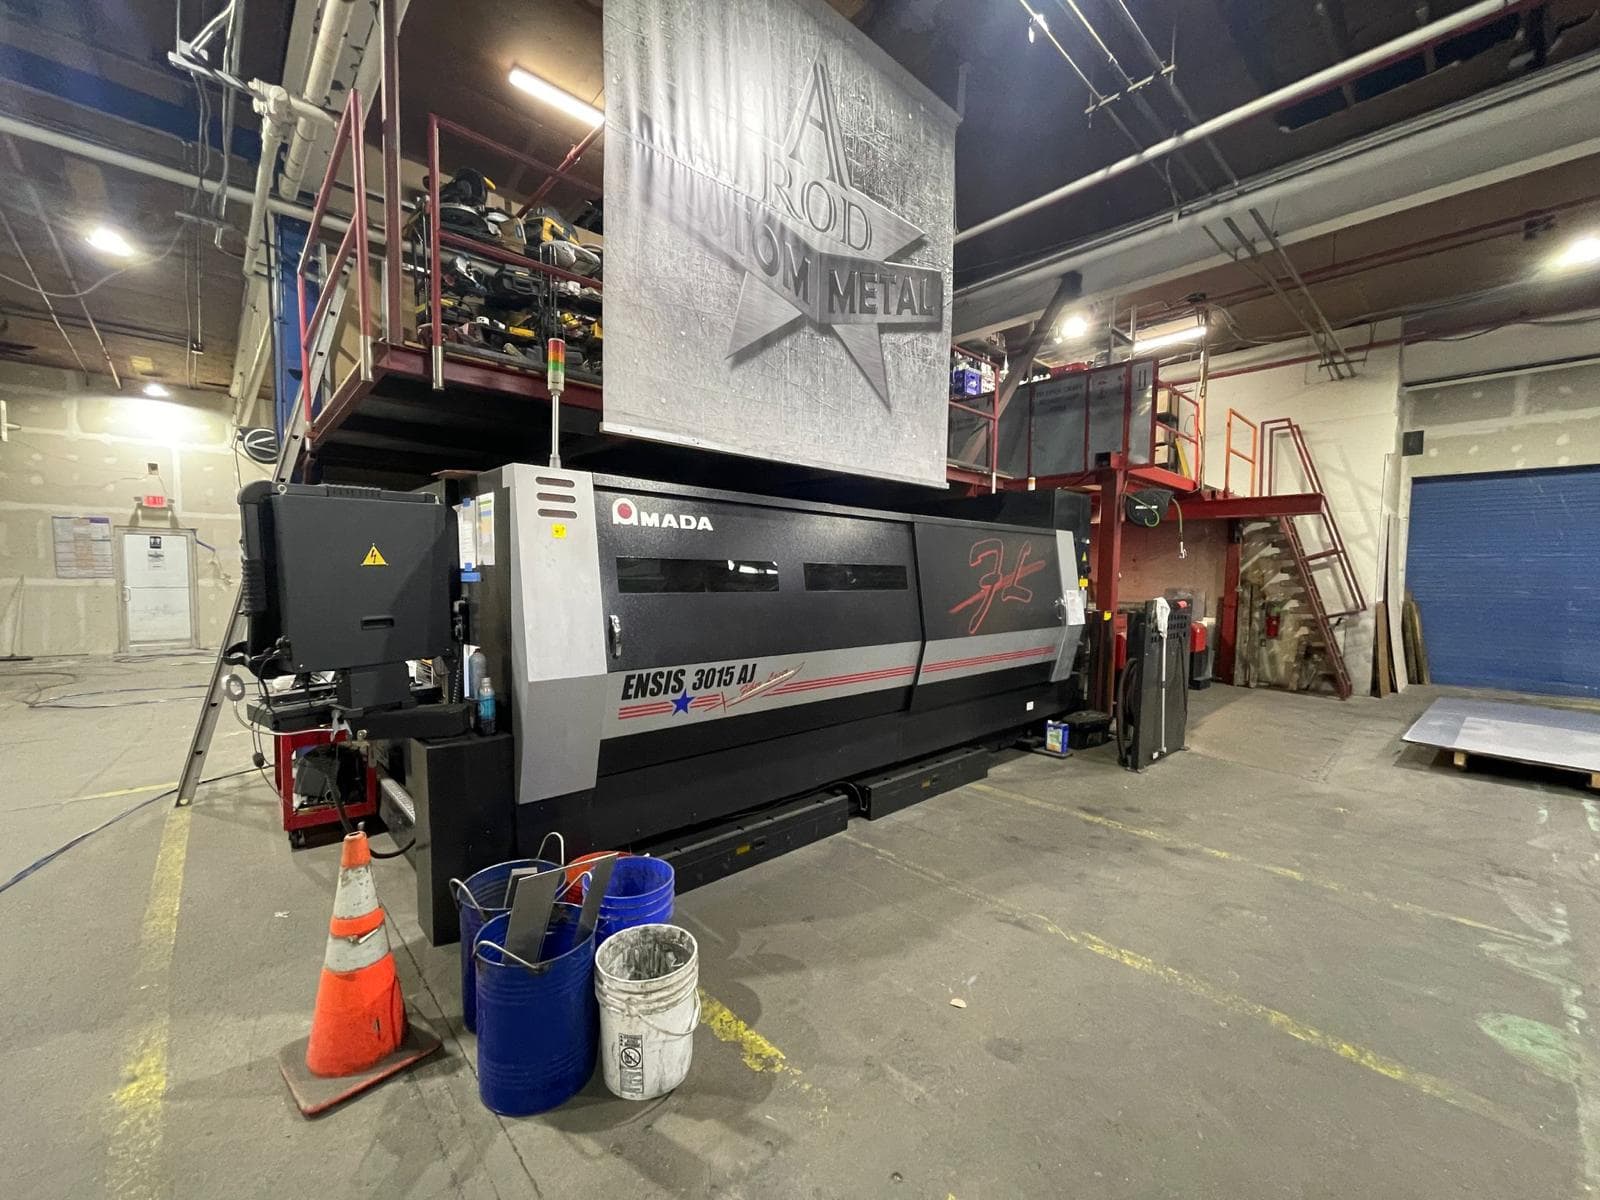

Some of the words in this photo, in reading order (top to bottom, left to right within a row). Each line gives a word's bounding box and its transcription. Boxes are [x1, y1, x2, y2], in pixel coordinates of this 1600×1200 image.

[788, 62, 849, 191] A
[763, 151, 873, 251] ROD
[827, 268, 935, 317] METAL
[612, 497, 714, 532] AMADA
[621, 668, 687, 701] ENSIS
[692, 665, 736, 691] 3015
[736, 663, 758, 685] AJ
